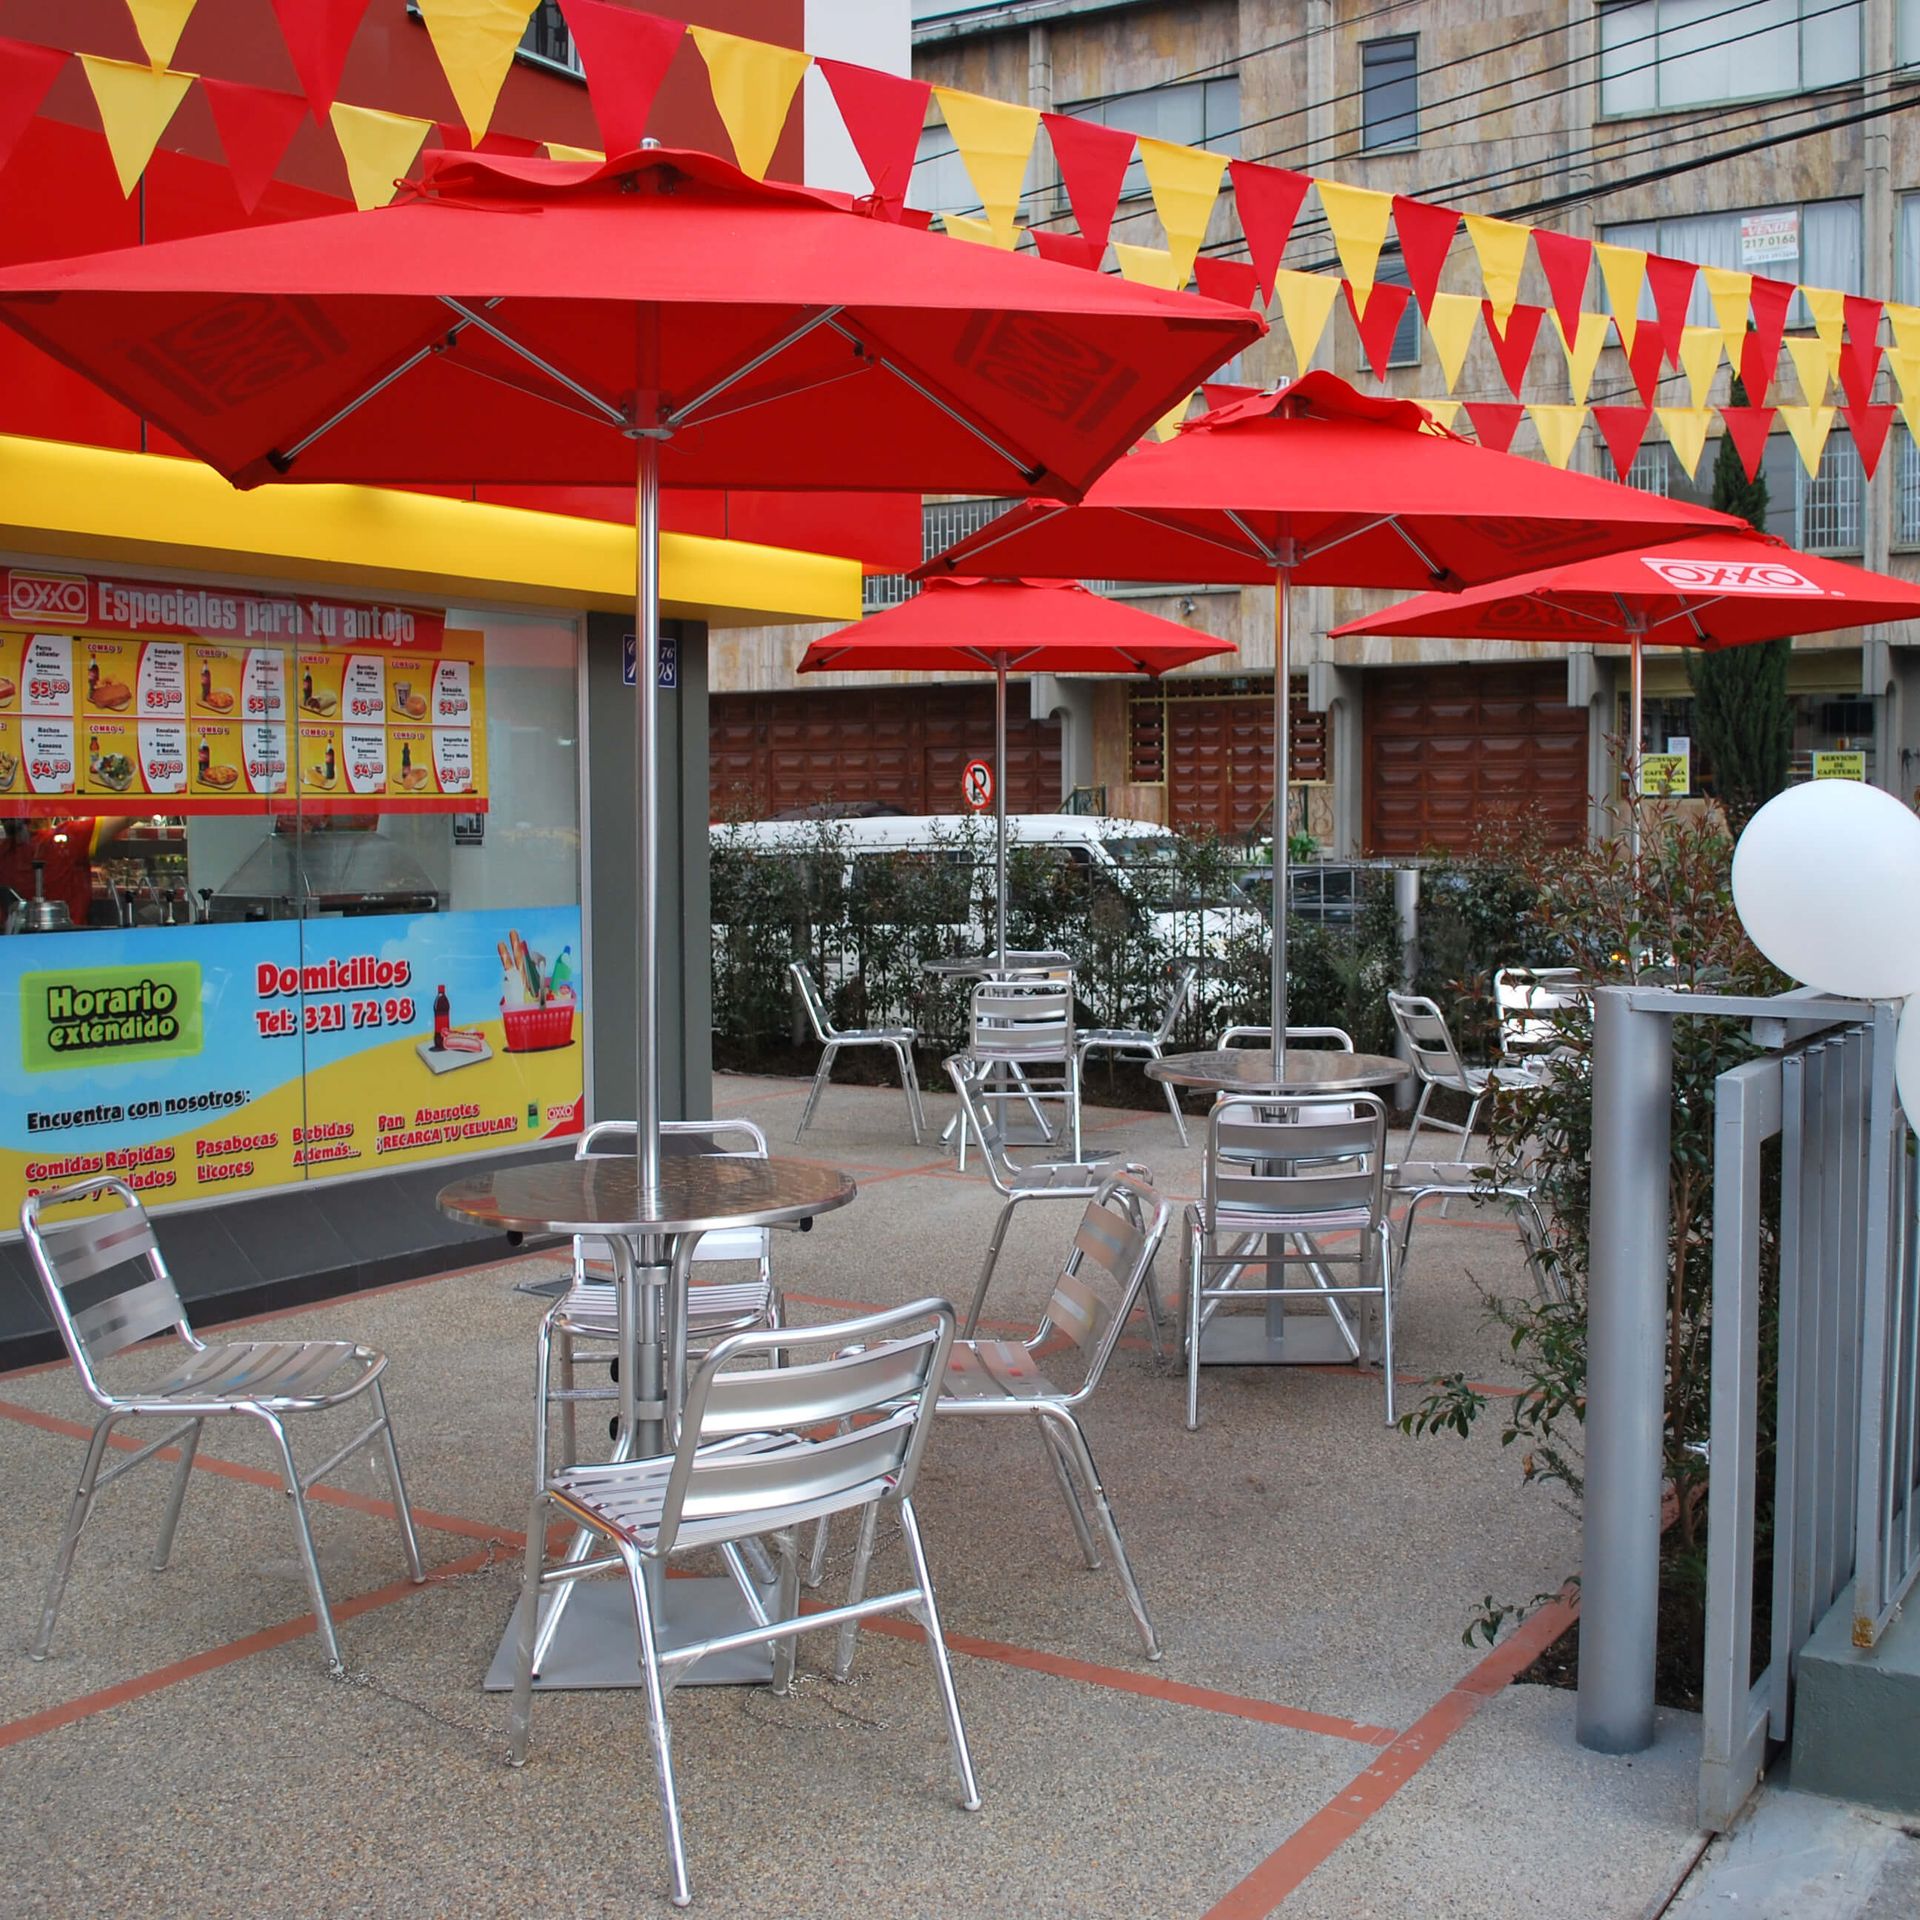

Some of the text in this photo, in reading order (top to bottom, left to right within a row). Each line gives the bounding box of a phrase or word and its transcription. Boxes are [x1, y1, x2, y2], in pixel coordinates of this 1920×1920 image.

[1744, 234, 1796, 249] 217 0166
[1660, 565, 1804, 587] OXXO
[12, 581, 85, 611] OXXO
[98, 582, 415, 646] Especiales para tu antojo
[441, 668, 455, 676] Café
[89, 725, 116, 734] COMBO
[301, 728, 326, 737] COMBO
[1817, 768, 1861, 776] CAFETERIA
[257, 955, 411, 998] Domicilios
[48, 979, 177, 1023] Horario
[256, 998, 415, 1038] Tel: 321 72 98
[48, 1014, 179, 1051] extendido
[27, 1090, 251, 1132] Encuentra con nosotros:
[378, 1103, 480, 1132] Pan Abarrotes
[547, 1105, 573, 1120] OXXO
[196, 1131, 279, 1158] Pasabocas
[292, 1122, 354, 1145] Bebidas
[376, 1116, 518, 1154] ¡RECARGA TU CELULAR!
[25, 1147, 175, 1182] Comidas Rápidas
[197, 1160, 254, 1184] Licores
